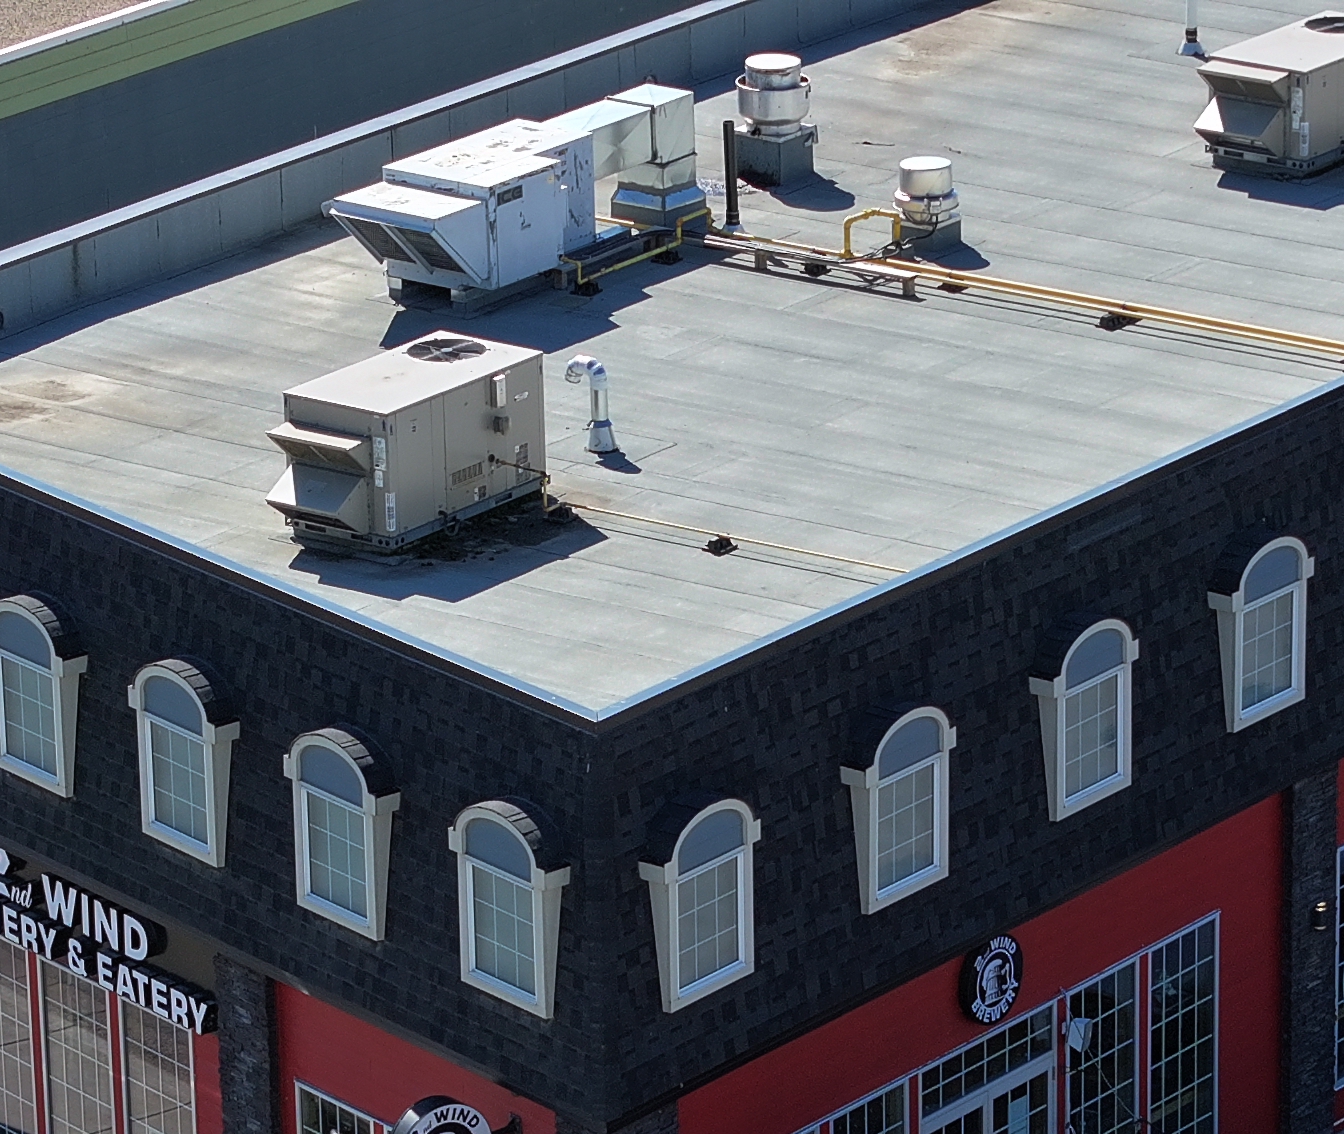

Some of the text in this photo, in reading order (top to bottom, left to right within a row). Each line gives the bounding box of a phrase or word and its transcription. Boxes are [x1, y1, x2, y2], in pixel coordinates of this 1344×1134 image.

[41, 873, 149, 961] WIND
[989, 936, 1017, 955] WIND
[67, 938, 88, 977] &
[96, 950, 208, 1036] EATERY
[971, 978, 1019, 1024] BREWERY
[434, 1108, 480, 1128] WIND
